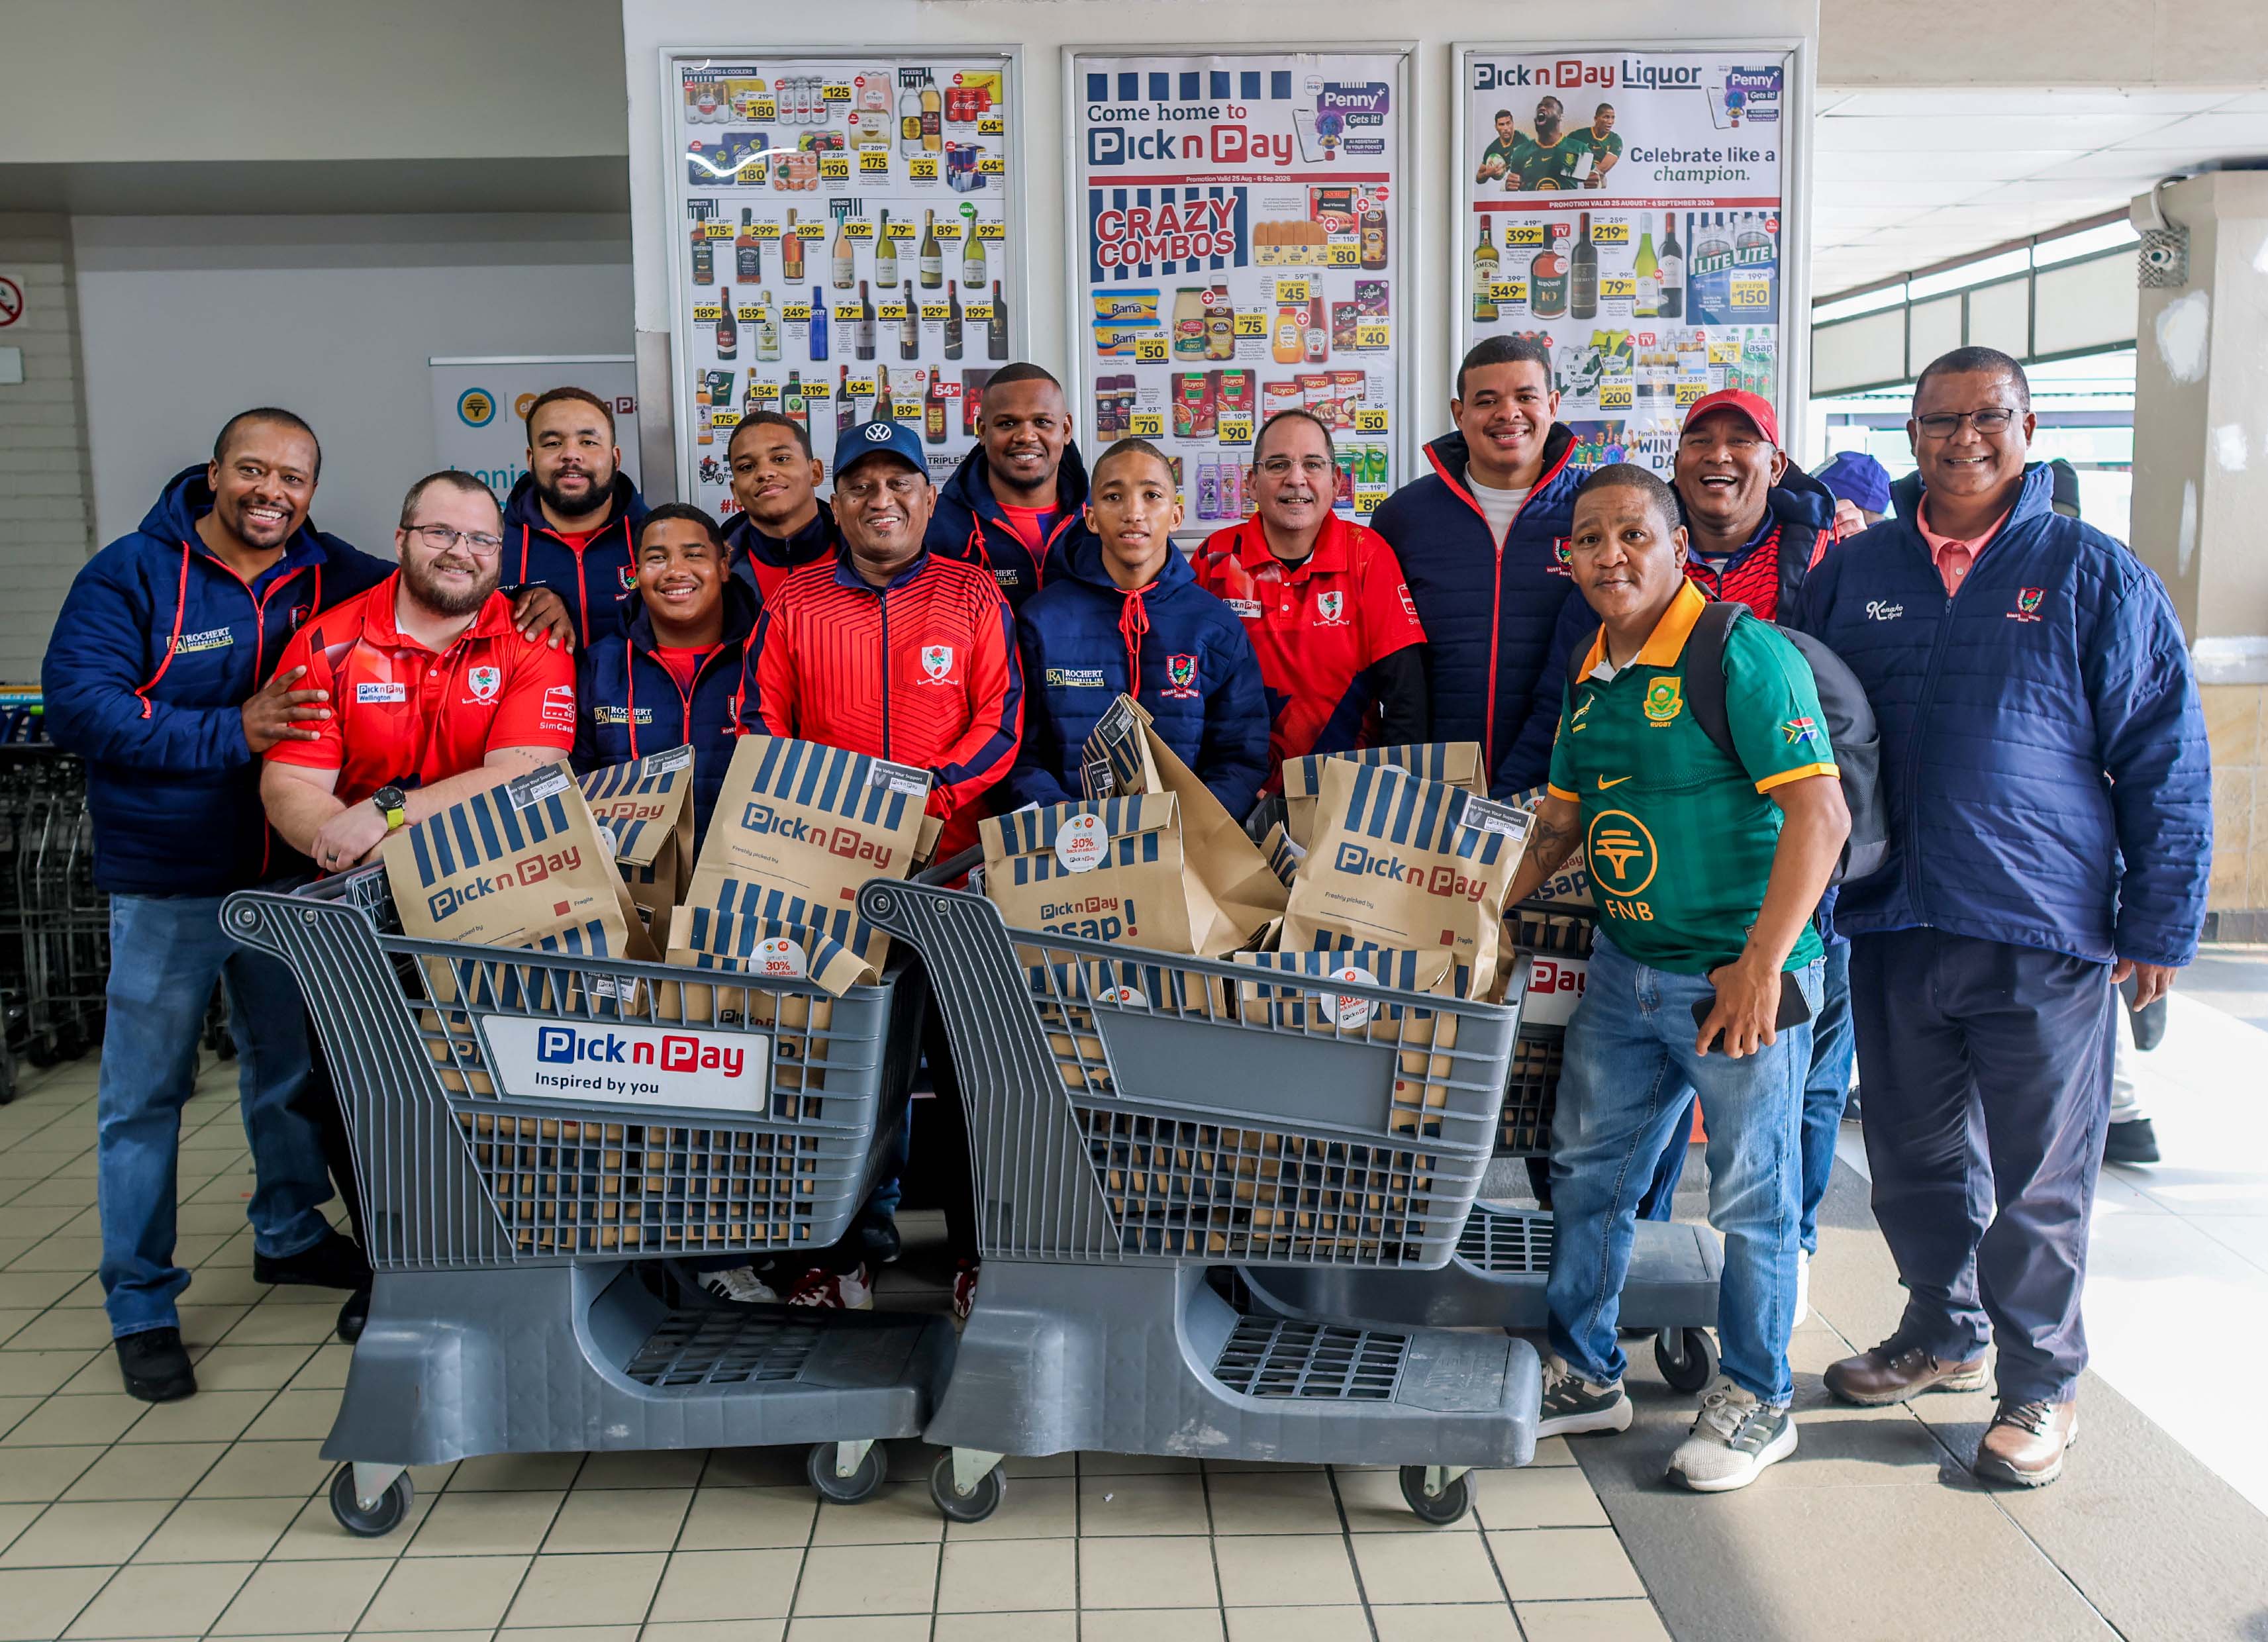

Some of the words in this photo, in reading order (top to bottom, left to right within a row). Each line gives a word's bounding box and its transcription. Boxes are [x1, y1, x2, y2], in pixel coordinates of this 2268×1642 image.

[1474, 63, 1531, 90] Pick
[1536, 68, 1550, 85] n
[1556, 60, 1615, 88] Pay
[1622, 60, 1702, 90] Liquor
[1732, 73, 1774, 88] Penny
[1324, 92, 1378, 110] Penny
[1087, 105, 1150, 121] Come
[1157, 103, 1220, 121] home
[1228, 104, 1246, 119] to
[1349, 115, 1369, 124] Gets
[1371, 114, 1380, 124] it!
[1087, 126, 1176, 166] Pick
[1182, 134, 1203, 159] n
[1210, 124, 1293, 166] Pay
[1630, 147, 1722, 163] Celebrate
[1728, 146, 1761, 162] like
[1765, 150, 1775, 162] a
[1654, 166, 1750, 184] champion.
[1097, 197, 1236, 242] CRAZY
[1554, 227, 1568, 236] TV
[1099, 231, 1234, 267] COMBOS
[1734, 246, 1769, 264] LITE
[1698, 253, 1731, 274] LITE
[1112, 303, 1142, 314] Rama
[1112, 334, 1136, 344] Ram
[1749, 344, 1772, 354] asap
[1638, 439, 1671, 454] WIN
[1652, 456, 1675, 469] DA
[1866, 600, 1903, 620] Kenako
[185, 627, 230, 642] ROCHERT
[358, 685, 379, 695] Pick
[385, 685, 403, 695] Pay
[539, 722, 573, 734] SimCash
[611, 802, 664, 821] Pay
[1503, 814, 1521, 824] Support
[741, 802, 810, 840] Pick
[809, 828, 826, 847] n
[828, 827, 893, 869] Pay
[1071, 838, 1094, 848] 30%
[732, 845, 752, 857] Freshly
[752, 849, 771, 861] picked
[770, 855, 779, 863] by
[1334, 842, 1406, 881] Pick
[1406, 867, 1424, 887] n
[1427, 866, 1487, 902] Pay
[428, 877, 495, 923] Pick
[495, 872, 514, 891] n
[515, 845, 581, 886] Pay
[1525, 871, 1588, 900] sap
[573, 896, 593, 907] Fragile
[1041, 902, 1073, 920] Pick
[1075, 901, 1084, 913] n
[1085, 896, 1118, 913] Pay
[1324, 891, 1346, 902] Freshly
[1346, 895, 1365, 906] picked
[1365, 900, 1374, 909] by
[1606, 900, 1653, 921] FNB
[1457, 936, 1473, 945] Fragile
[765, 961, 790, 971] 30%
[538, 1026, 626, 1063] Pick
[633, 1041, 655, 1065] n
[661, 1034, 744, 1078] Pay
[535, 1072, 603, 1092] Inspired
[607, 1076, 626, 1094] by
[630, 1080, 659, 1094] you
